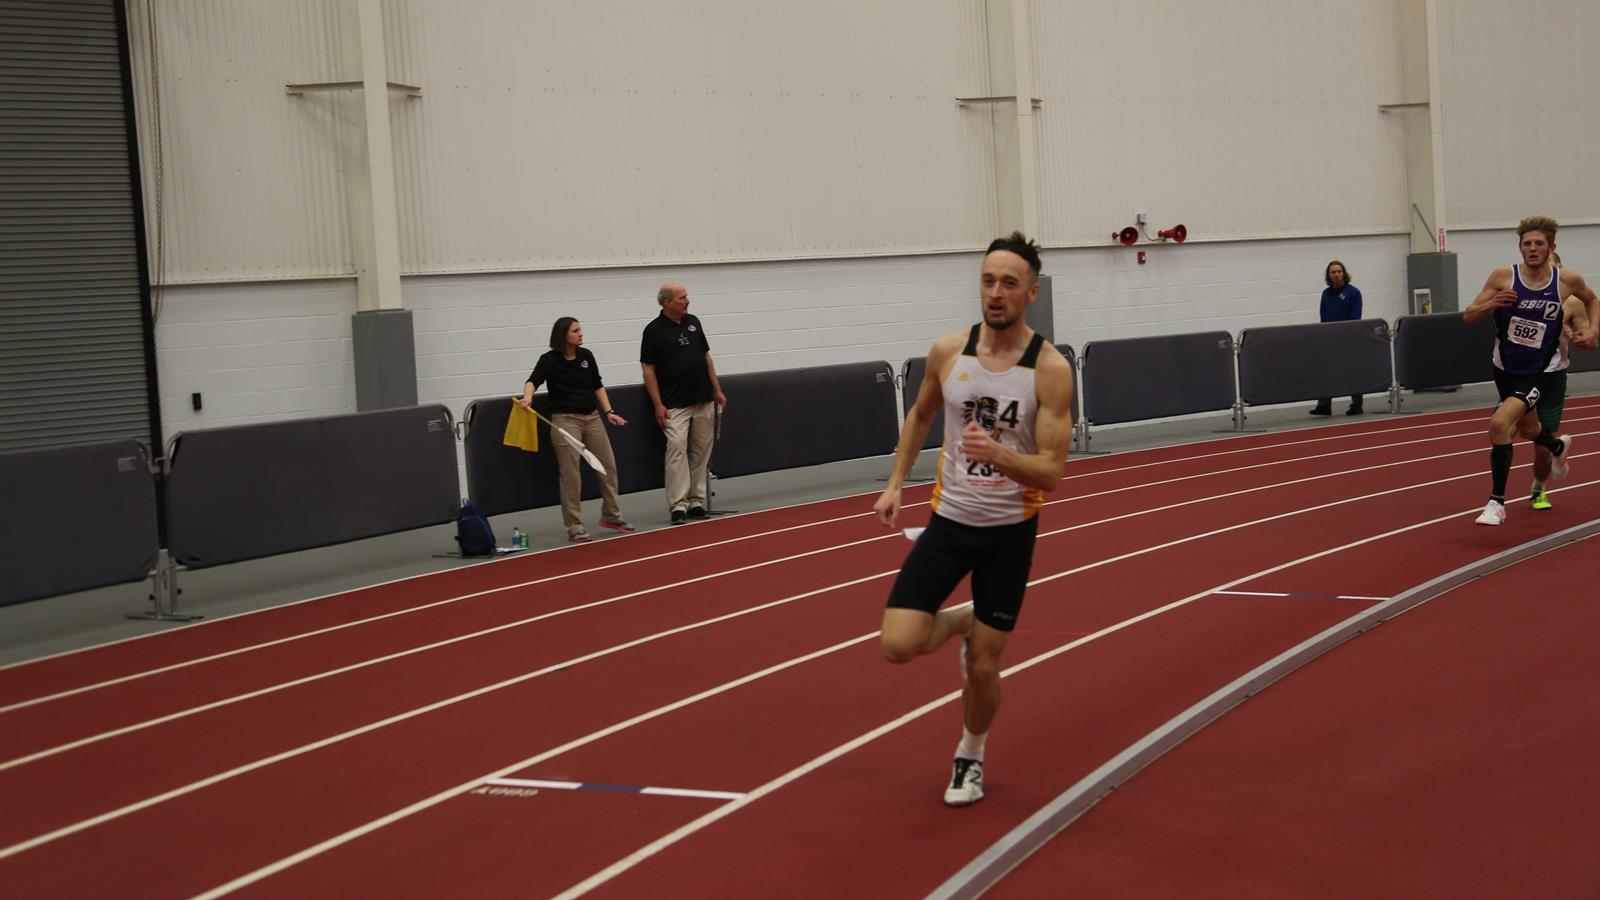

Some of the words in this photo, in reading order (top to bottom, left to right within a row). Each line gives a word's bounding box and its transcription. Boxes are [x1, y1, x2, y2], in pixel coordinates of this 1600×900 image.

[1518, 300, 1545, 309] SBU
[1546, 303, 1558, 319] 2
[1514, 326, 1538, 340] 592
[1528, 391, 1539, 404] 2
[1000, 401, 1019, 428] 4
